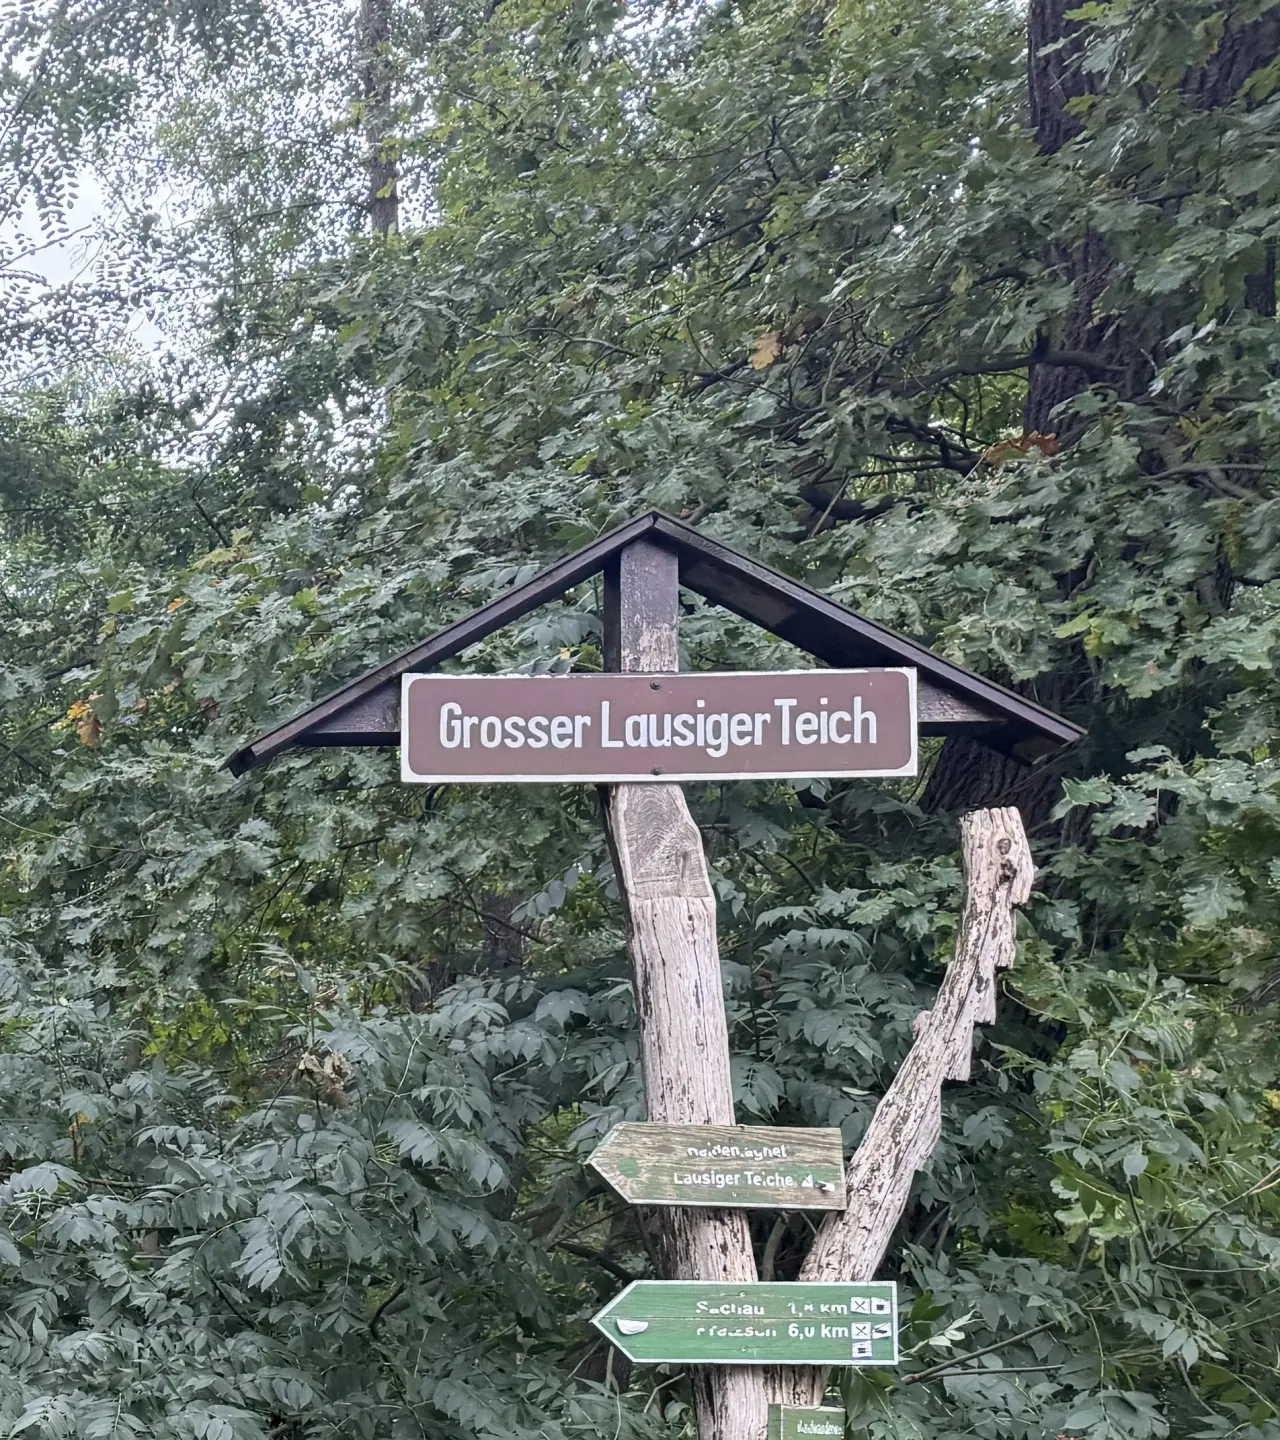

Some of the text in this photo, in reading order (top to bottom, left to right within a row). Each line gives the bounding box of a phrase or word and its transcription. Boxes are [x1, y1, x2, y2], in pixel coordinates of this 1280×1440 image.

[439, 695, 877, 757] Grosser Lausiger Teich
[673, 1170, 794, 1188] Lausiger Teiche
[819, 1302, 848, 1315] km
[820, 1323, 849, 1338] km
